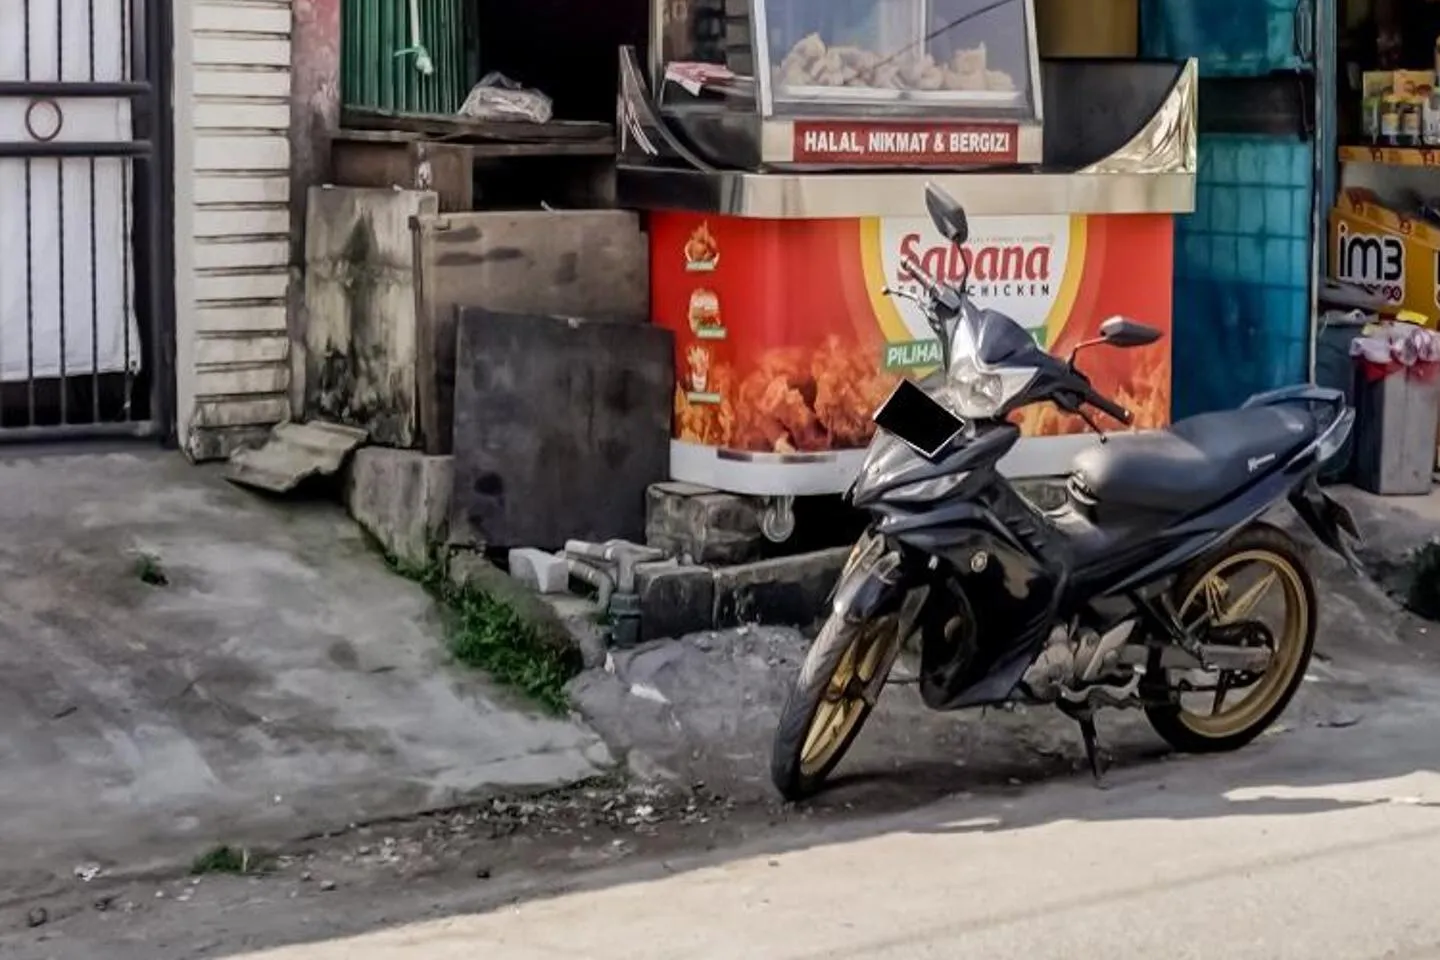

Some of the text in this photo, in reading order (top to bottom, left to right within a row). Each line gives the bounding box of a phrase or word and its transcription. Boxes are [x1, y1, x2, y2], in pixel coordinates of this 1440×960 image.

[804, 131, 1010, 154] HALAL, NIKMAT & BERGIZI
[897, 233, 1051, 285] Sabana
[1340, 224, 1403, 280] im3
[968, 284, 1050, 297] CHICKEN
[886, 343, 943, 368] PILIHA
